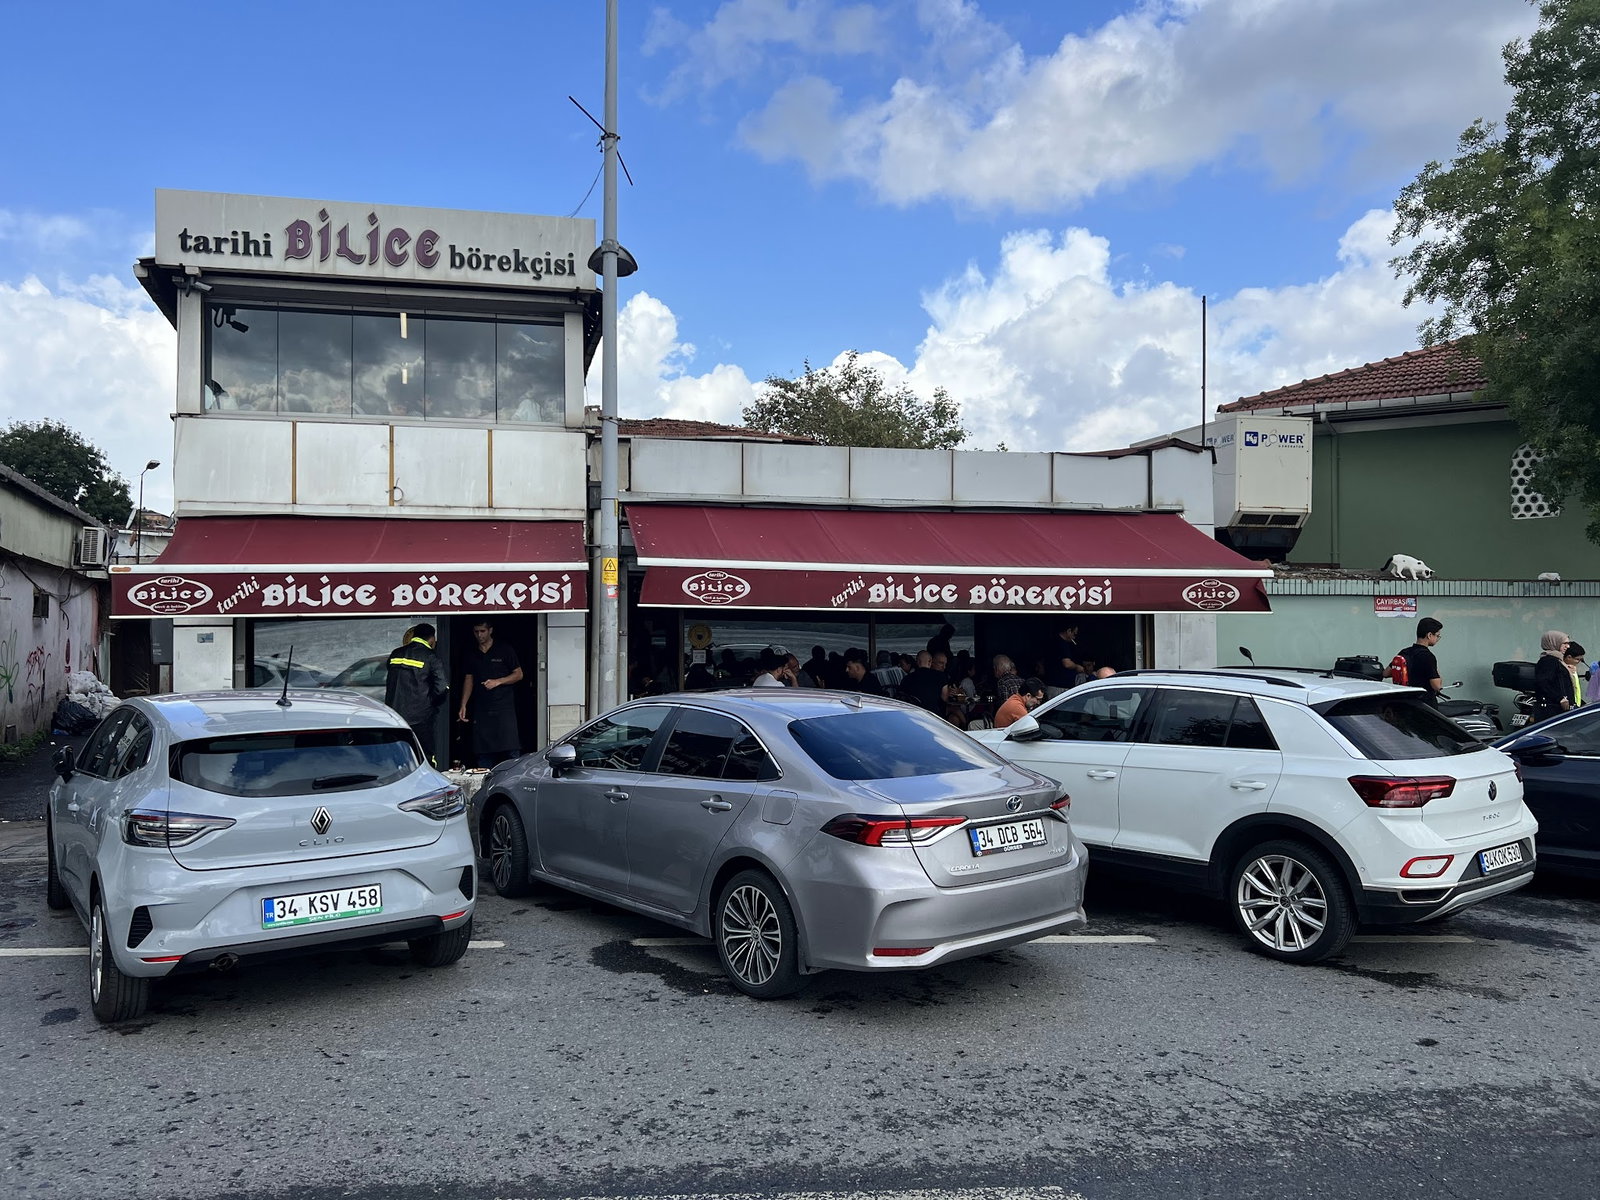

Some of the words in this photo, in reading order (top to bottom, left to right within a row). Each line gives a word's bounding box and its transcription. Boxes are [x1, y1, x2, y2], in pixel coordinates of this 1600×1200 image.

[178, 226, 272, 258] tarihi
[449, 244, 577, 280] börekçisi
[217, 576, 261, 615] tarihi
[391, 573, 573, 610] BÖREKÇİSİ
[831, 578, 866, 608] tarihi
[969, 576, 1114, 610] BÖREKÇİSİ
[299, 836, 344, 846] CLIO
[978, 829, 994, 848] 34
[998, 825, 1019, 845] DCB
[1022, 821, 1042, 841] 564
[276, 899, 298, 919] 34
[308, 893, 340, 915] KSV
[347, 888, 378, 909] 458
